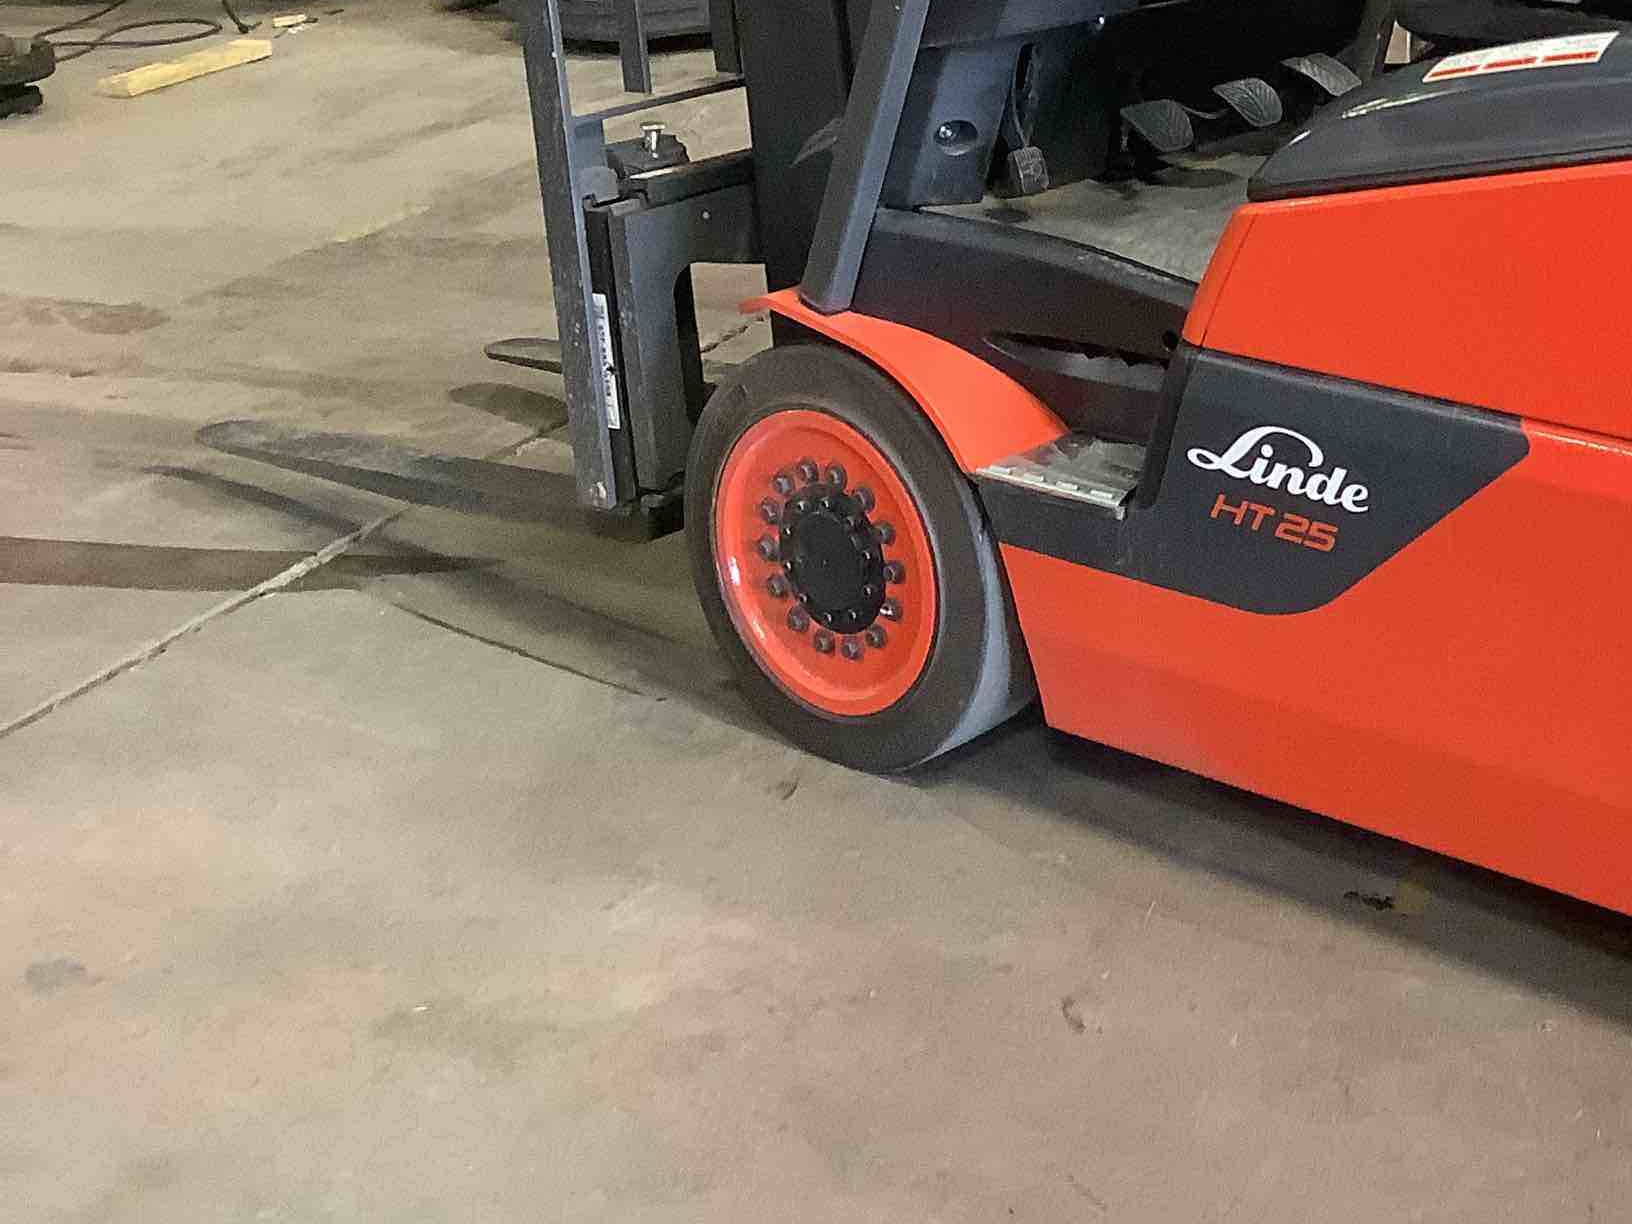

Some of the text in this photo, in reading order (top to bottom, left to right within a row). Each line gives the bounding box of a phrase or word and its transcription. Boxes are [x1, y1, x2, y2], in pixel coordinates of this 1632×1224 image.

[1187, 425, 1369, 513] Linde
[1209, 493, 1339, 553] HT 25
